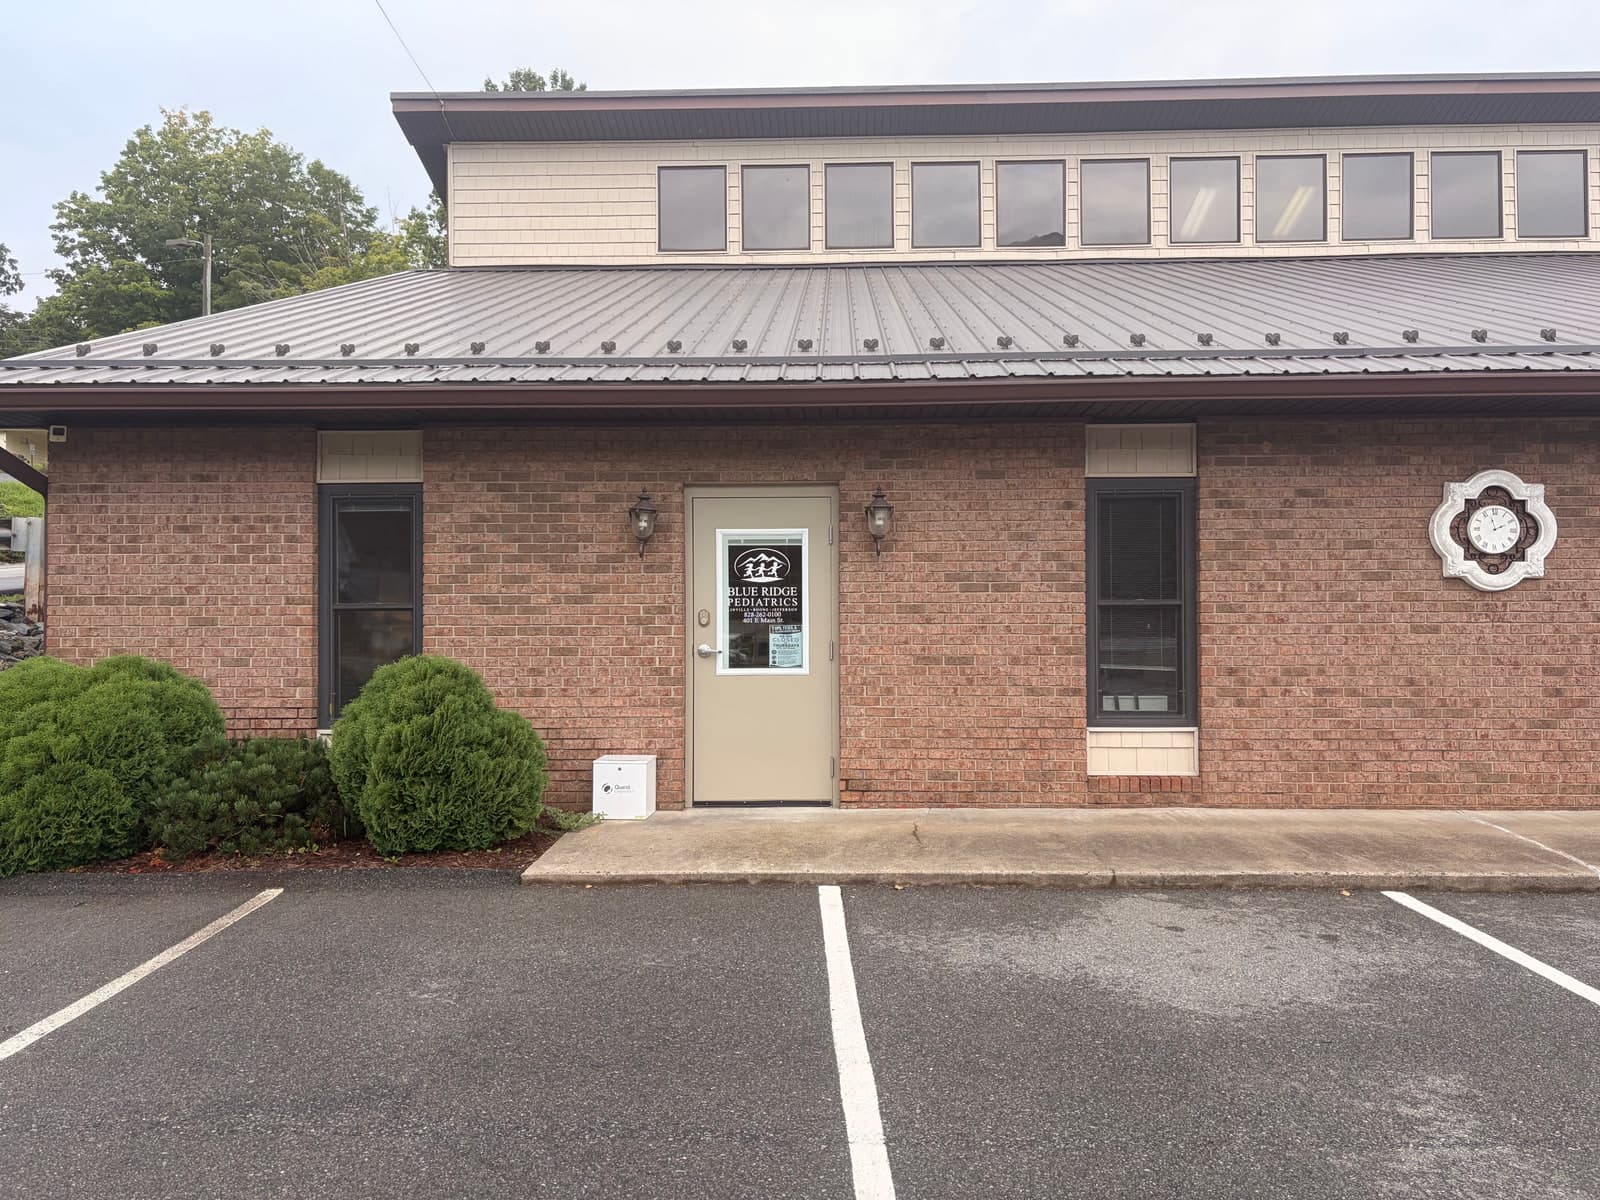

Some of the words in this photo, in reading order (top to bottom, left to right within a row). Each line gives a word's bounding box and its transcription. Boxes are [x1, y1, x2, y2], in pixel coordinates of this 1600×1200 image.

[728, 587, 758, 596] BLUE
[761, 587, 798, 596] RIDGE
[728, 598, 798, 606] PEDIATRICS
